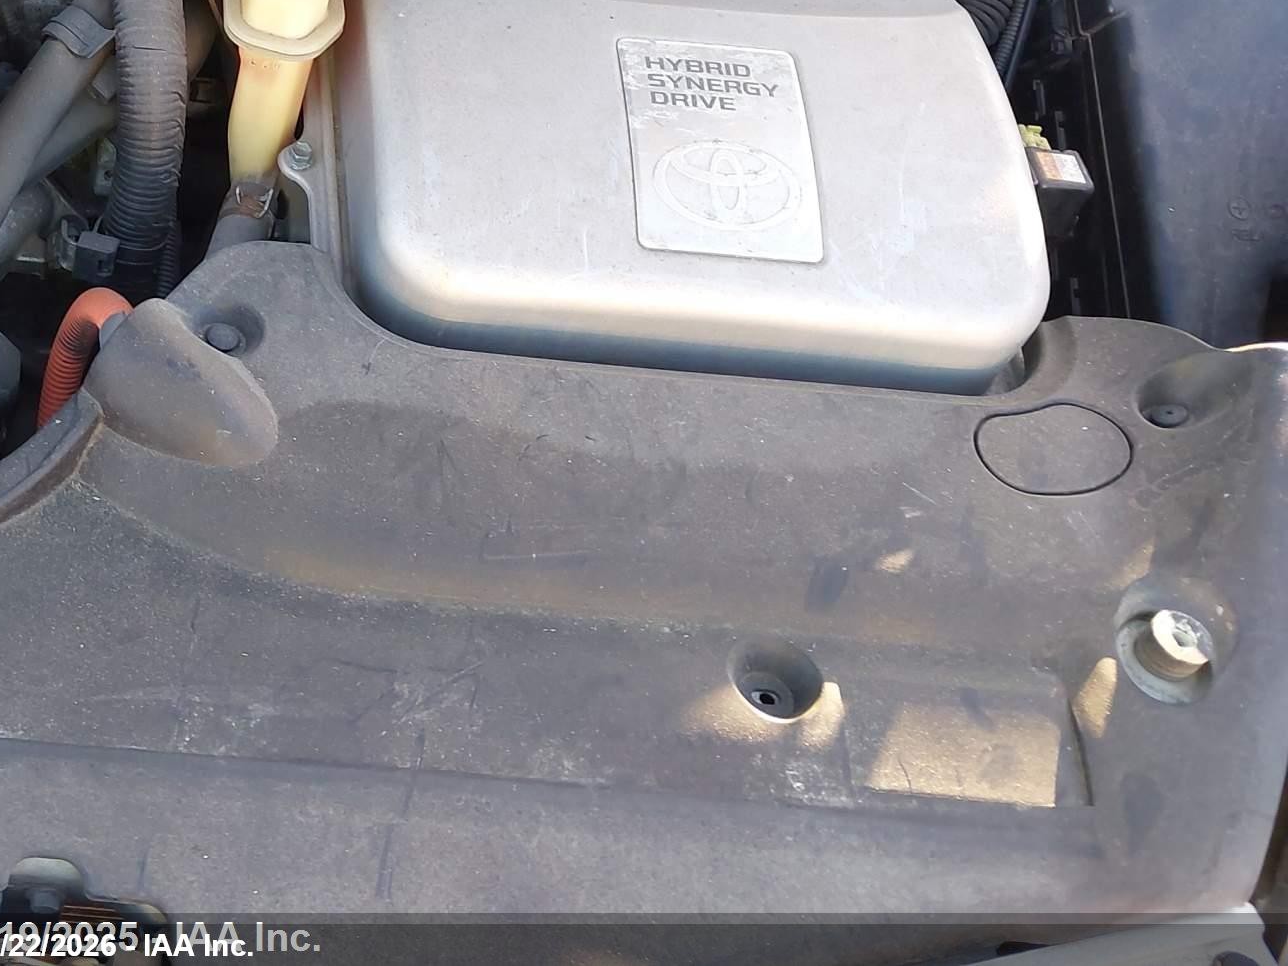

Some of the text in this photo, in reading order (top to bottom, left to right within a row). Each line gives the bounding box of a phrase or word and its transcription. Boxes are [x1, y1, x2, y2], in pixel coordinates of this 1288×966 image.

[644, 56, 751, 78] HYBRID
[647, 73, 779, 98] SYNERGY
[650, 91, 737, 111] DRIVE
